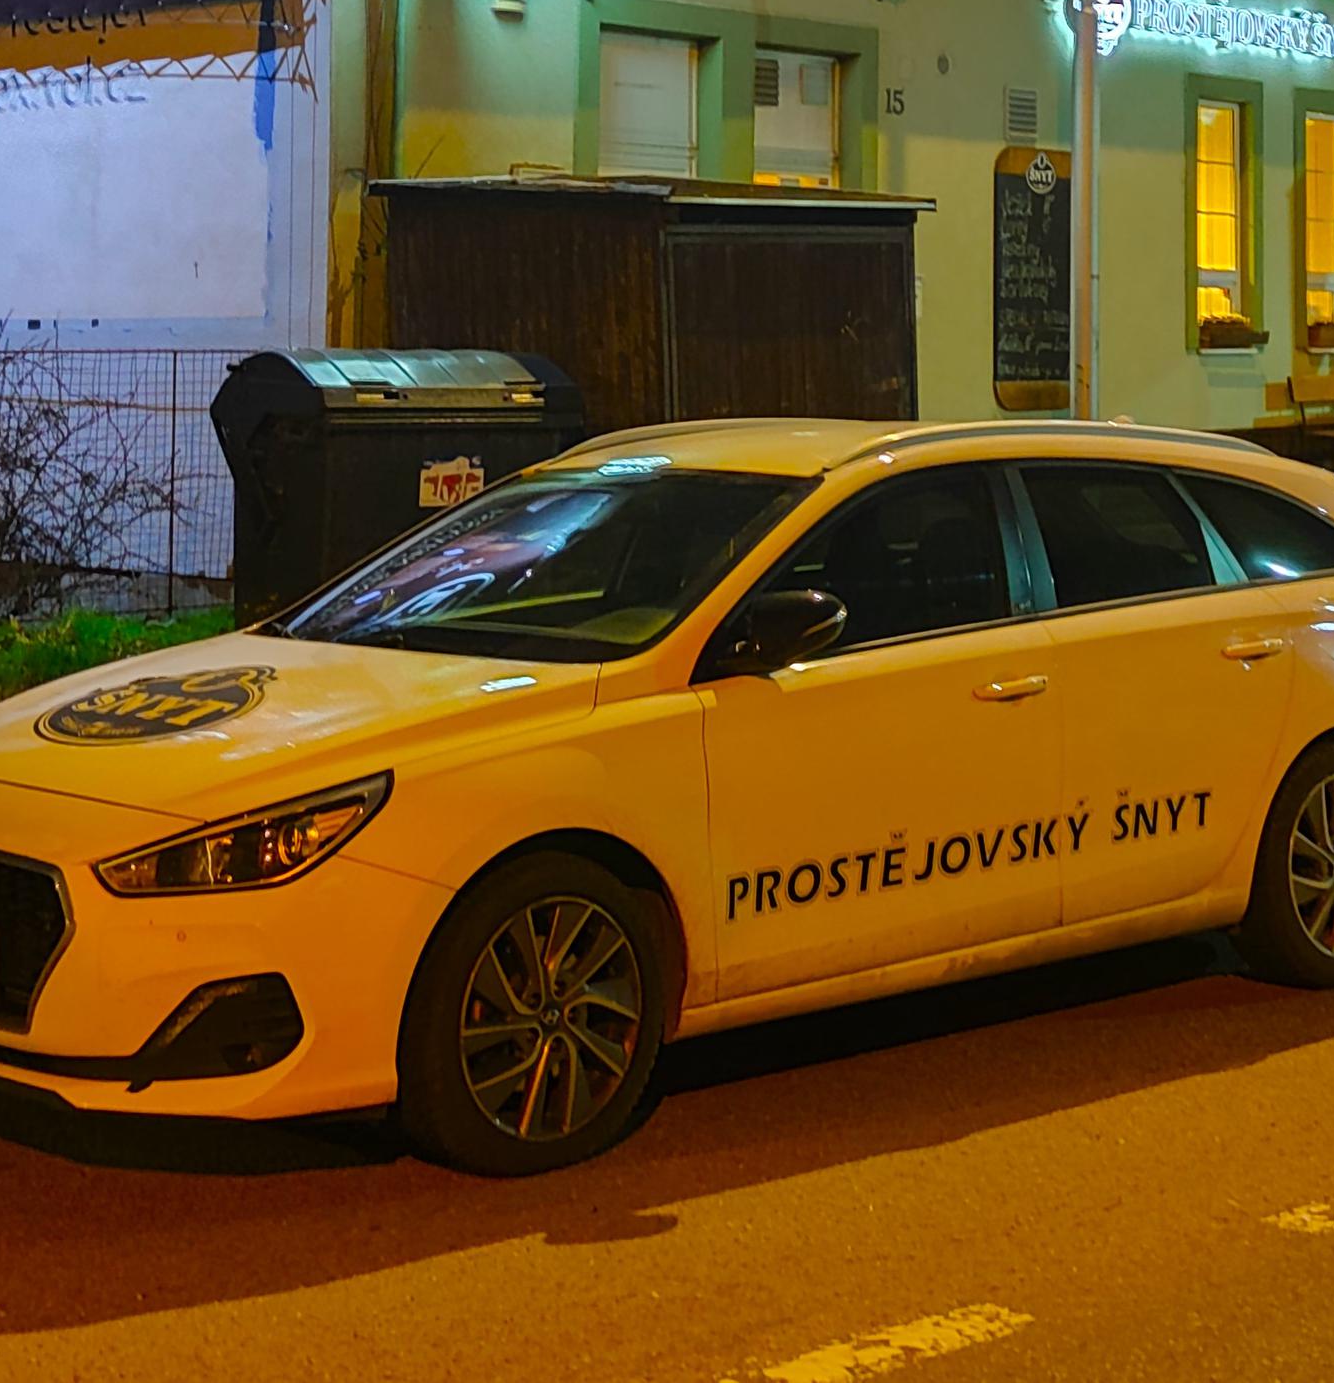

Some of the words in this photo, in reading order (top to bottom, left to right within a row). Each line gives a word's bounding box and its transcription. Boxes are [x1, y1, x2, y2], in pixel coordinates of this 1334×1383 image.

[885, 87, 905, 116] 15
[725, 796, 1091, 921] PROSTĚJOVSKÝ
[1112, 787, 1213, 843] ŠNYT
